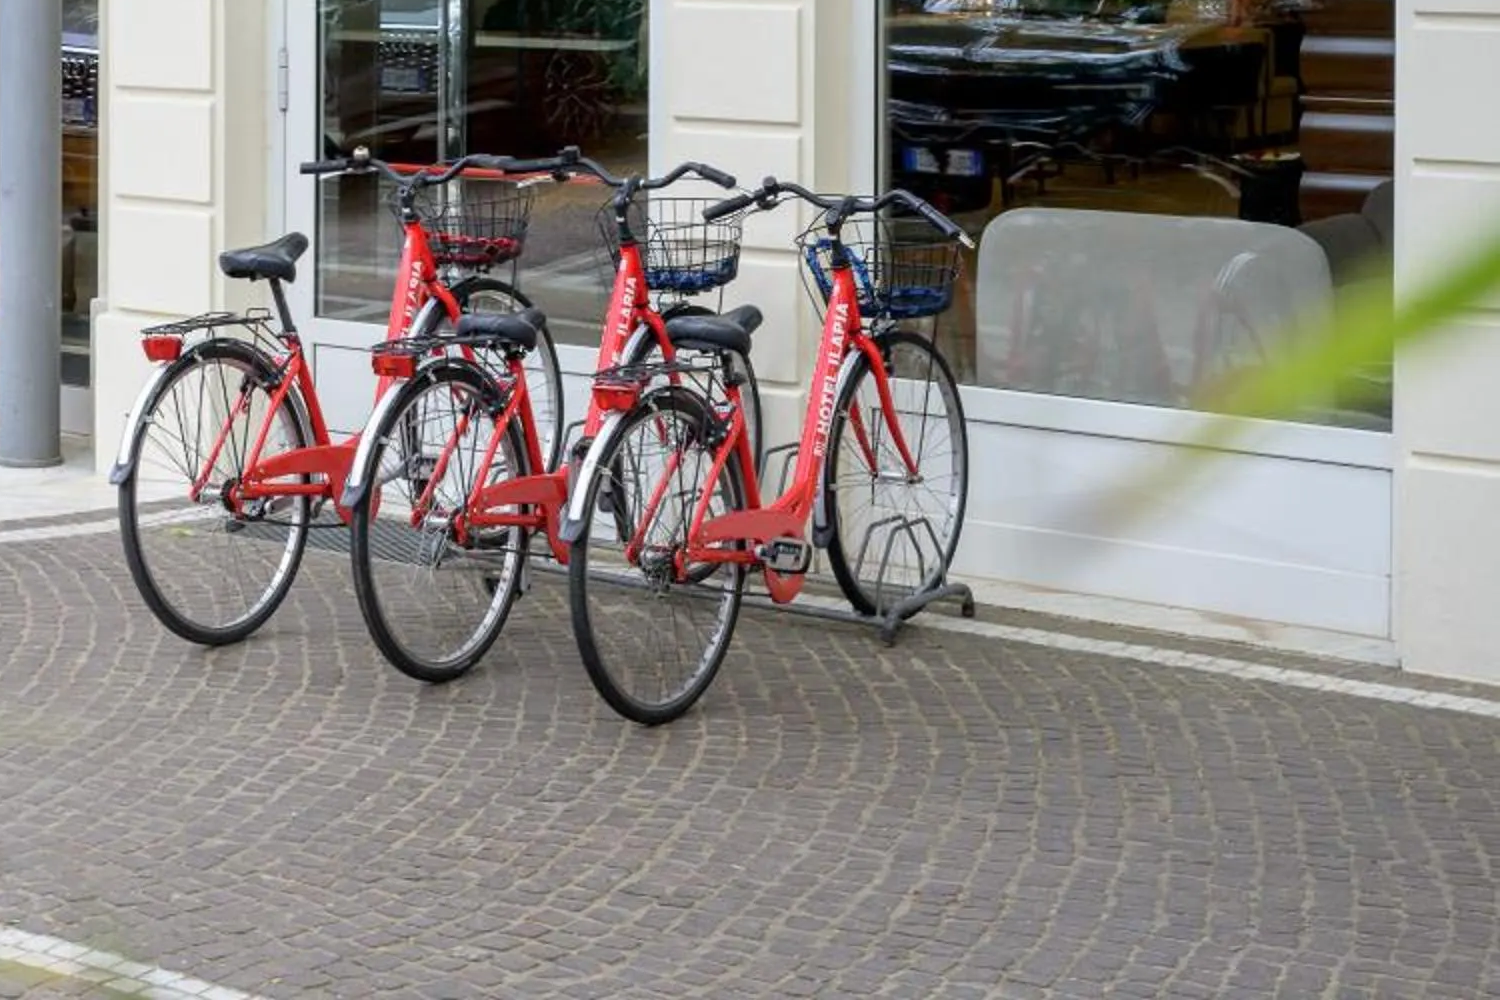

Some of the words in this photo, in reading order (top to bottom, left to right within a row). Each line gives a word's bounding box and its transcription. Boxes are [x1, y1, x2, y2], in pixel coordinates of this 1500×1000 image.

[617, 277, 637, 337] ILARIA
[817, 374, 837, 438] HOTEL
[827, 303, 849, 365] ILARIA
